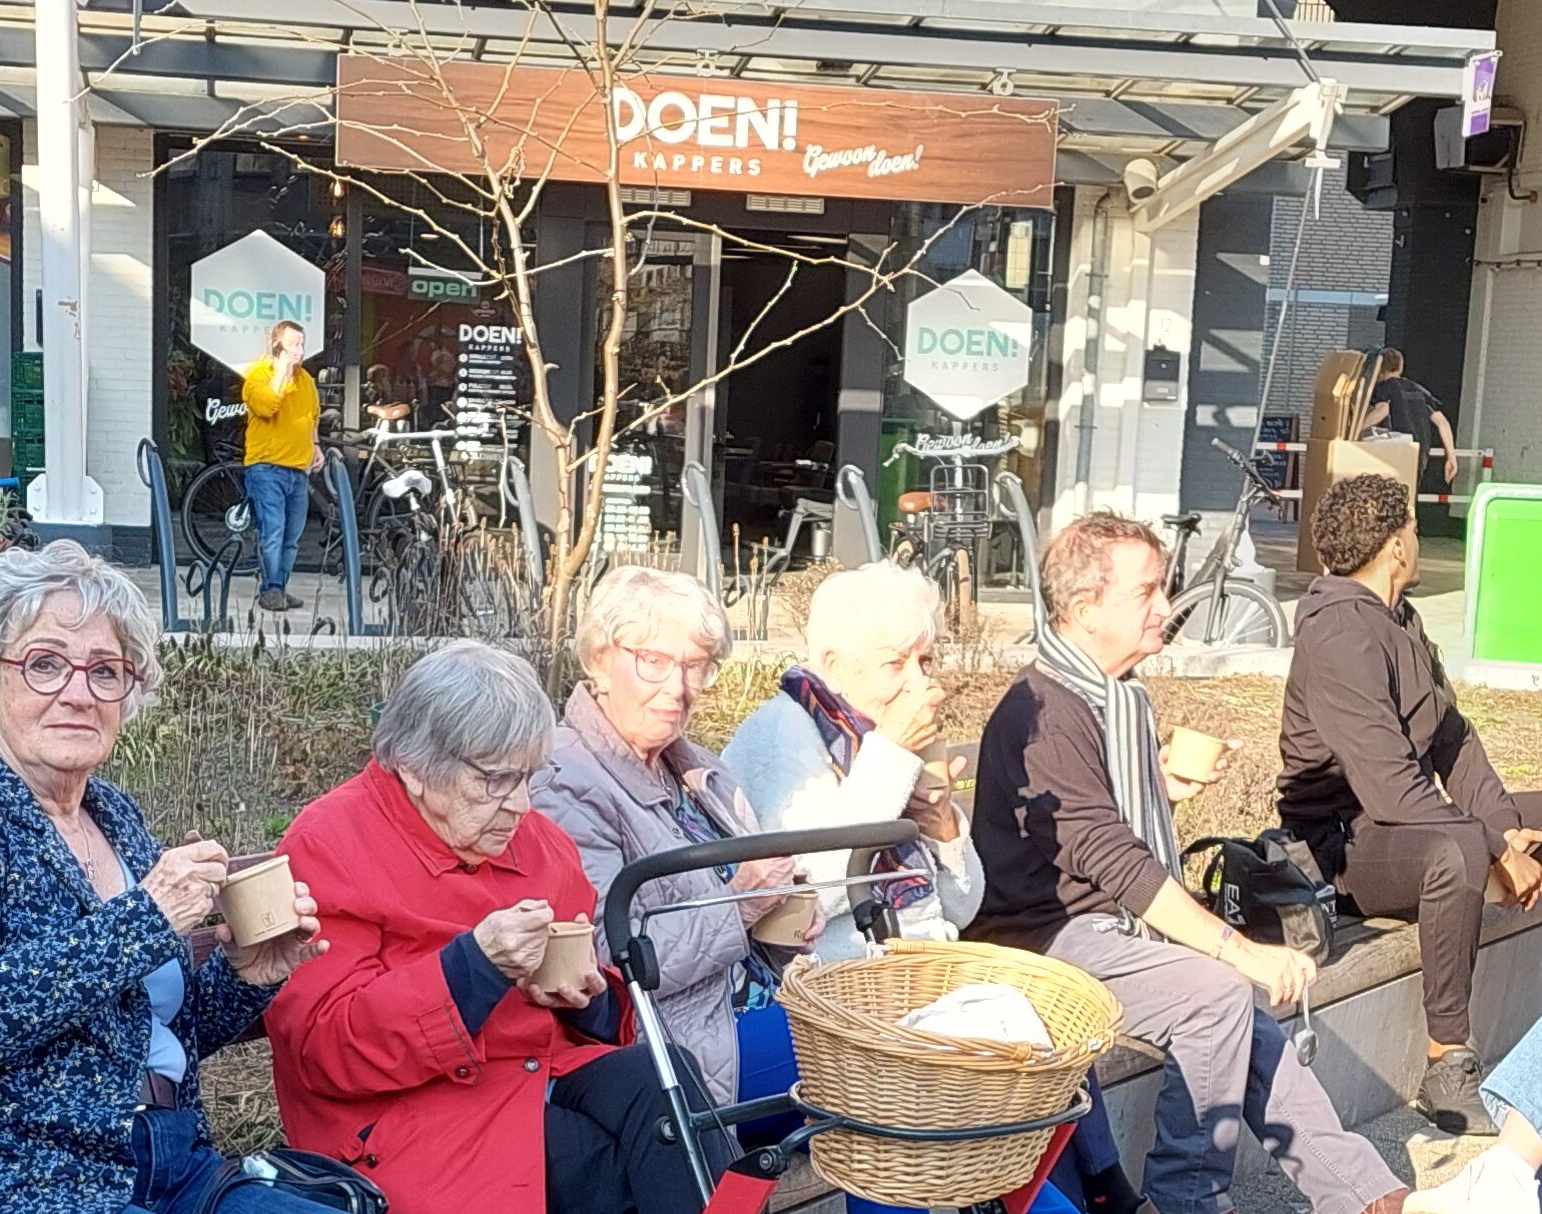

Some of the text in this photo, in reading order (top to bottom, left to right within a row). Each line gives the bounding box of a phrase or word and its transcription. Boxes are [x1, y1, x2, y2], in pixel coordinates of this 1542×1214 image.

[613, 87, 799, 150] DOEN!
[633, 151, 762, 176] KAPPERS
[802, 143, 924, 178] Gewoon doen!
[411, 279, 478, 298] open
[203, 287, 313, 323] DOEN!
[219, 324, 270, 336] KAPPE
[459, 324, 523, 345] DOEN!
[917, 326, 1019, 358] DOEN!
[930, 360, 1000, 372] KAPPERS
[205, 397, 249, 426] Gewo
[1227, 883, 1247, 926] EA7
